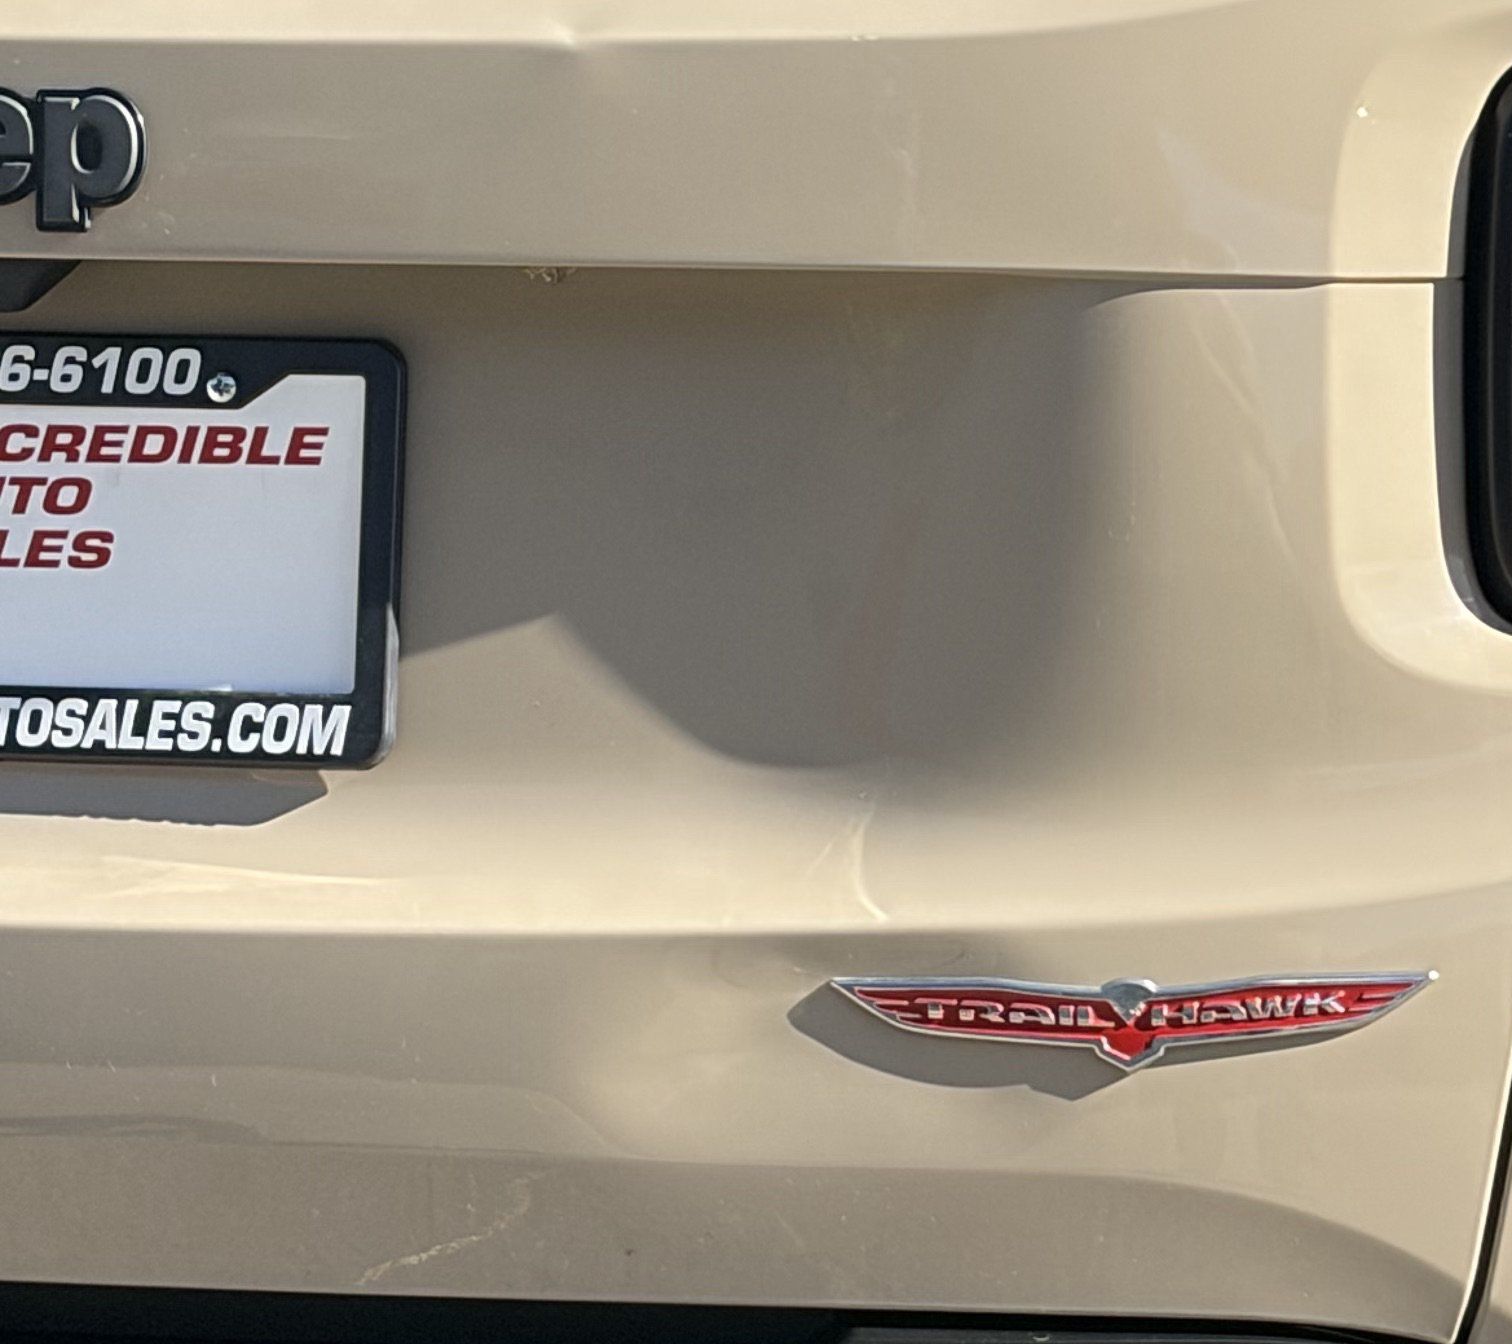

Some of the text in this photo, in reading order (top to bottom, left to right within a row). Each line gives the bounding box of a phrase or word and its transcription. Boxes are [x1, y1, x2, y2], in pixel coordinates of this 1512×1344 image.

[0, 344, 202, 396] 6-6100
[0, 424, 330, 465] CREDIBLE
[0, 476, 93, 515] TO
